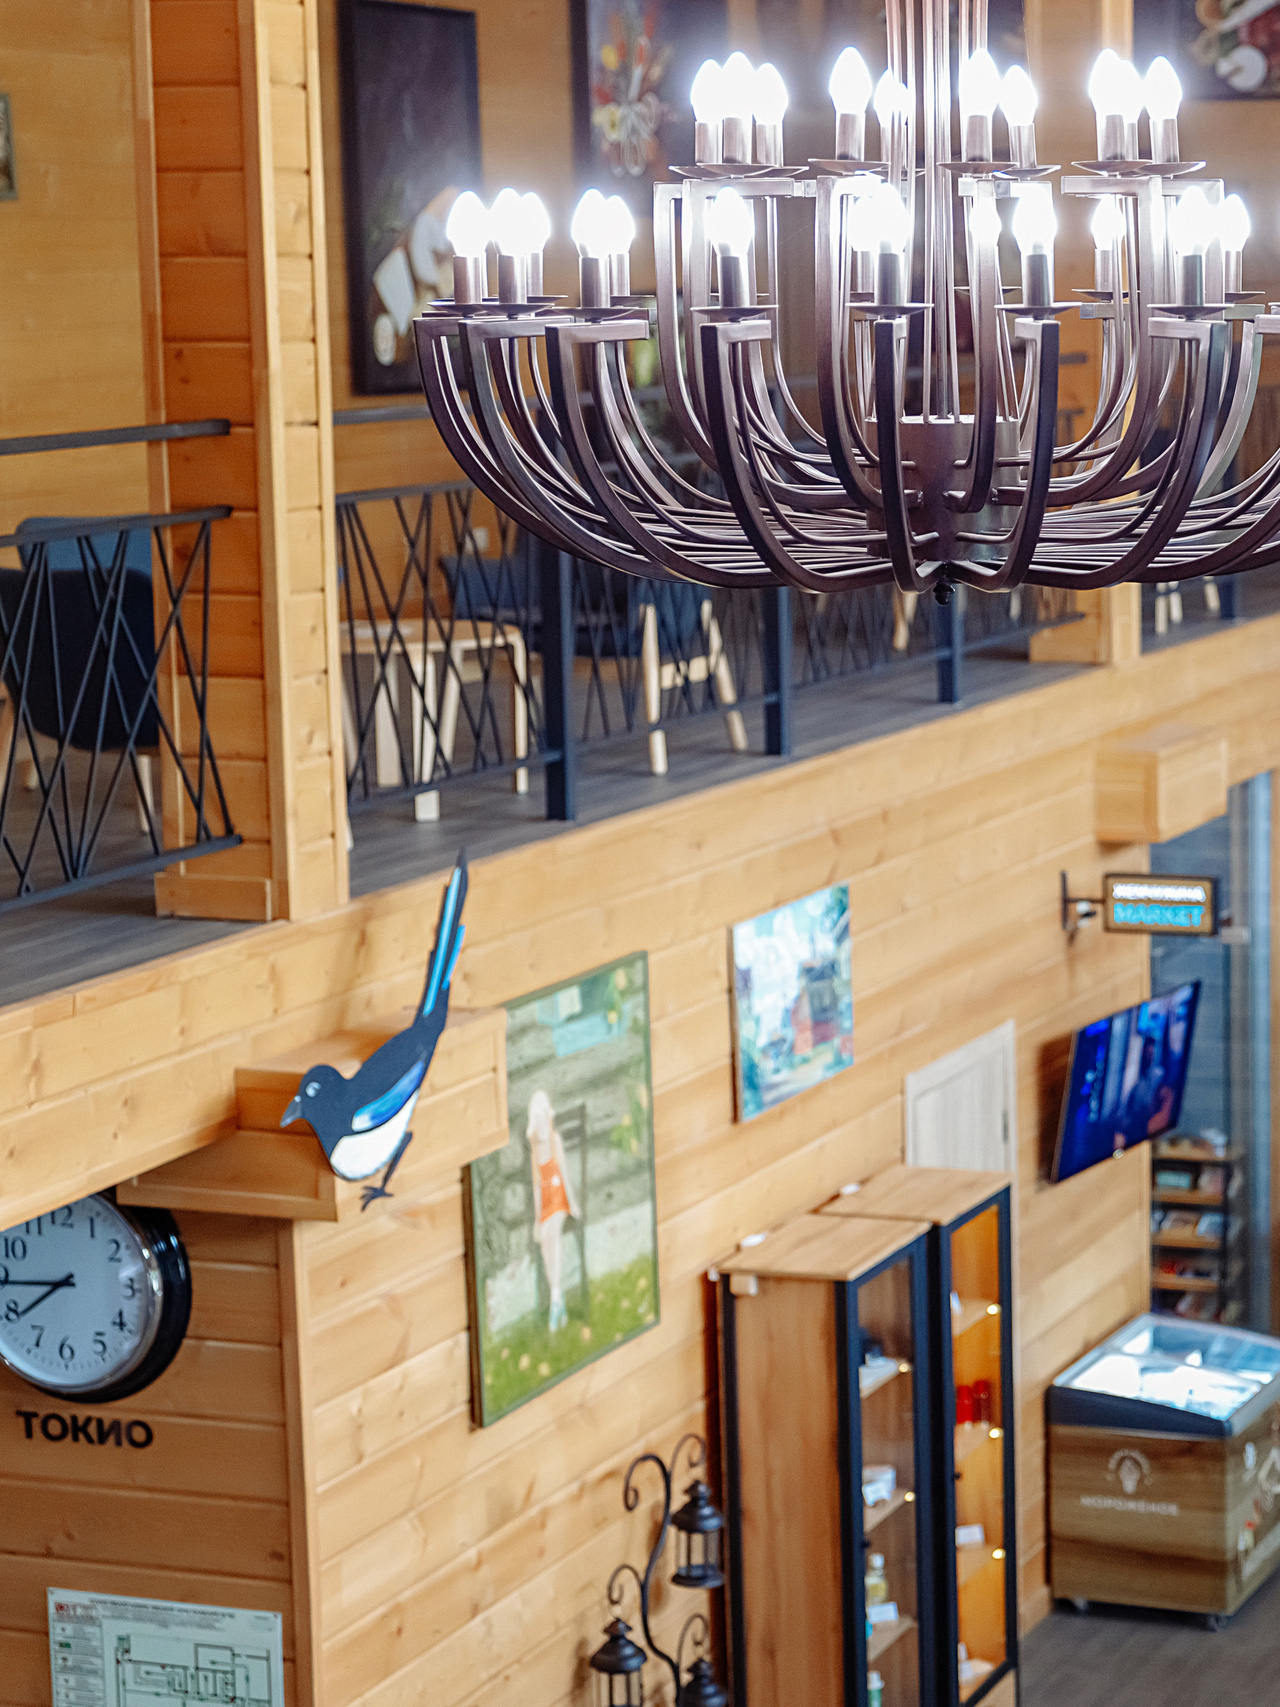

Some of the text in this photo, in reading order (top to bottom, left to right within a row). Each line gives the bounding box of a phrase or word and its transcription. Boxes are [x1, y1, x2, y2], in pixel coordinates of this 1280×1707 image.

[1113, 902, 1206, 927] MARKET
[50, 1205, 74, 1229] 12
[89, 1216, 96, 1239] 1
[3, 1236, 27, 1261] 10
[107, 1238, 122, 1263] 2
[122, 1277, 136, 1300] 3
[4, 1298, 20, 1324] 8
[111, 1308, 127, 1332] 4
[30, 1324, 45, 1348] 7
[58, 1335, 75, 1362] 6
[91, 1331, 107, 1357] 5
[15, 1410, 154, 1449] ТОКИО
